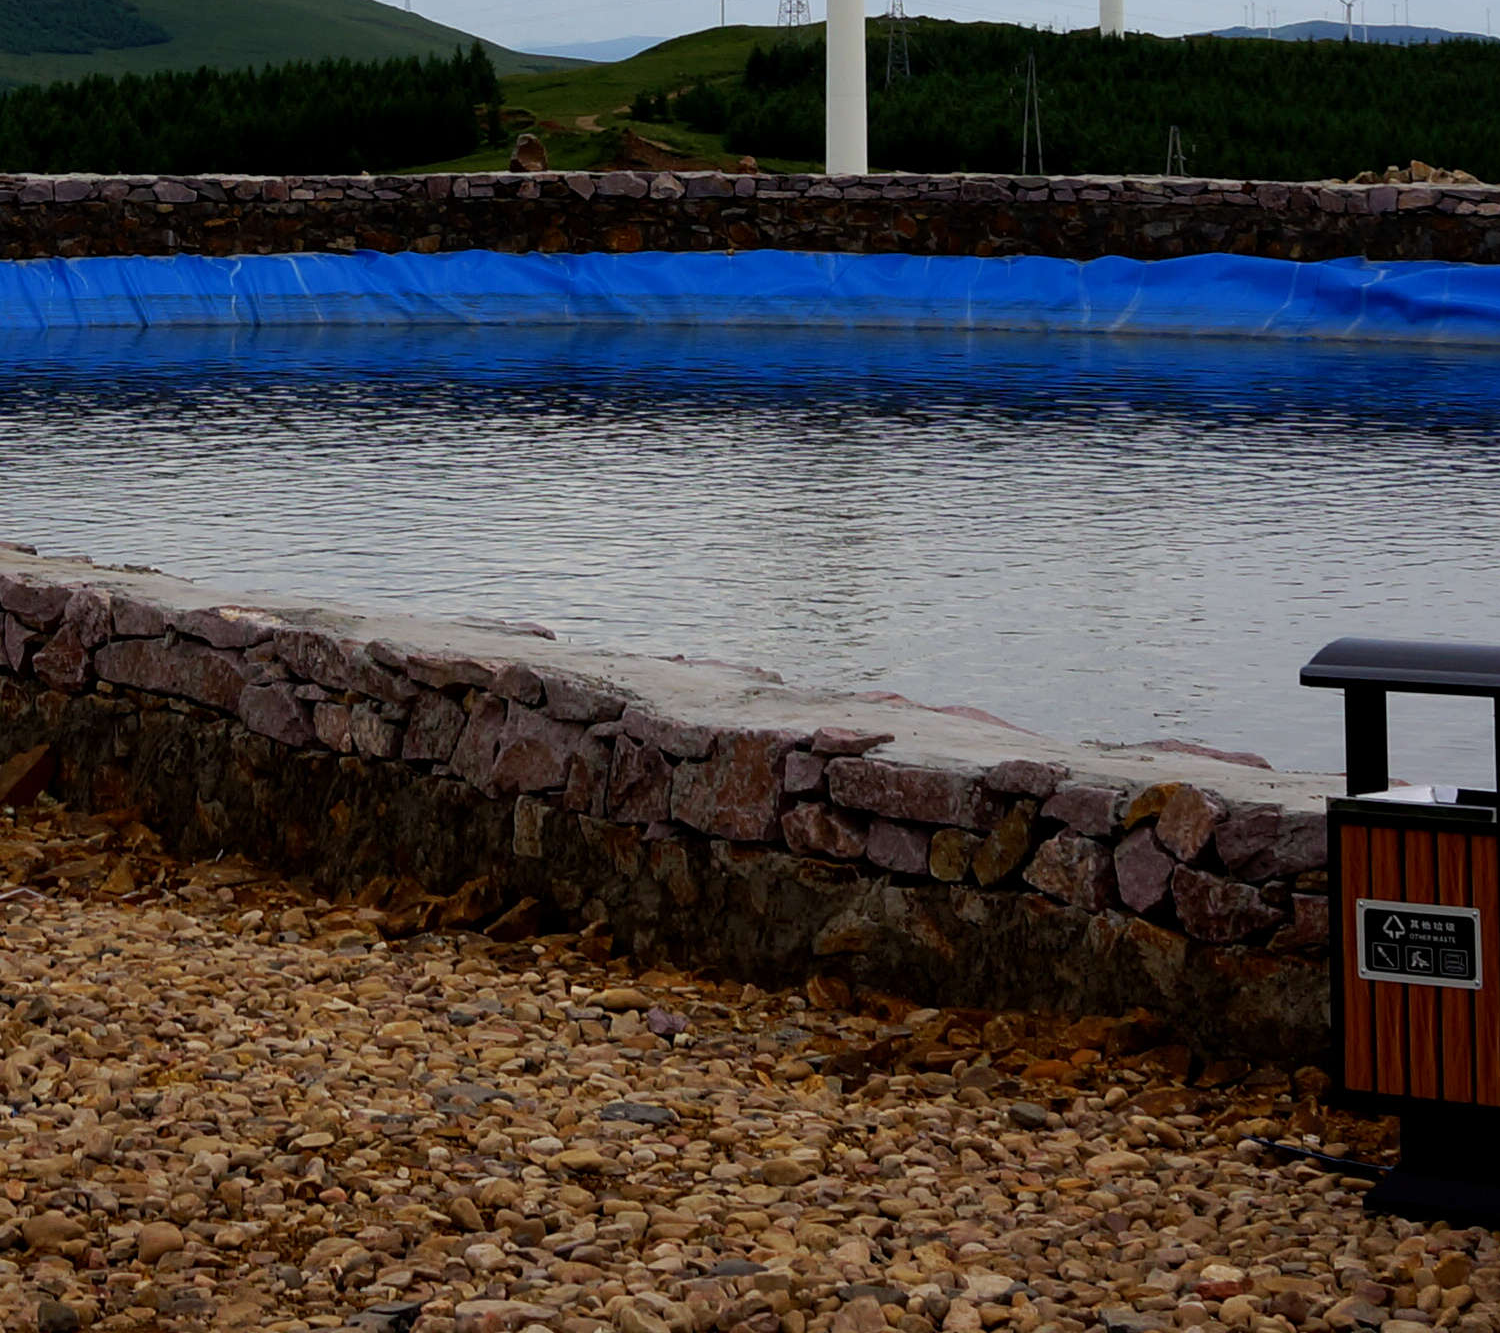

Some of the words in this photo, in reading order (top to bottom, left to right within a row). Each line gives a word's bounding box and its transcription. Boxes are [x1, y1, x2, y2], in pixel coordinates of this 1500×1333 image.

[1409, 918, 1456, 933] 其他垃圾
[1409, 933, 1431, 941] OTHER
[1432, 935, 1456, 944] WASTE
